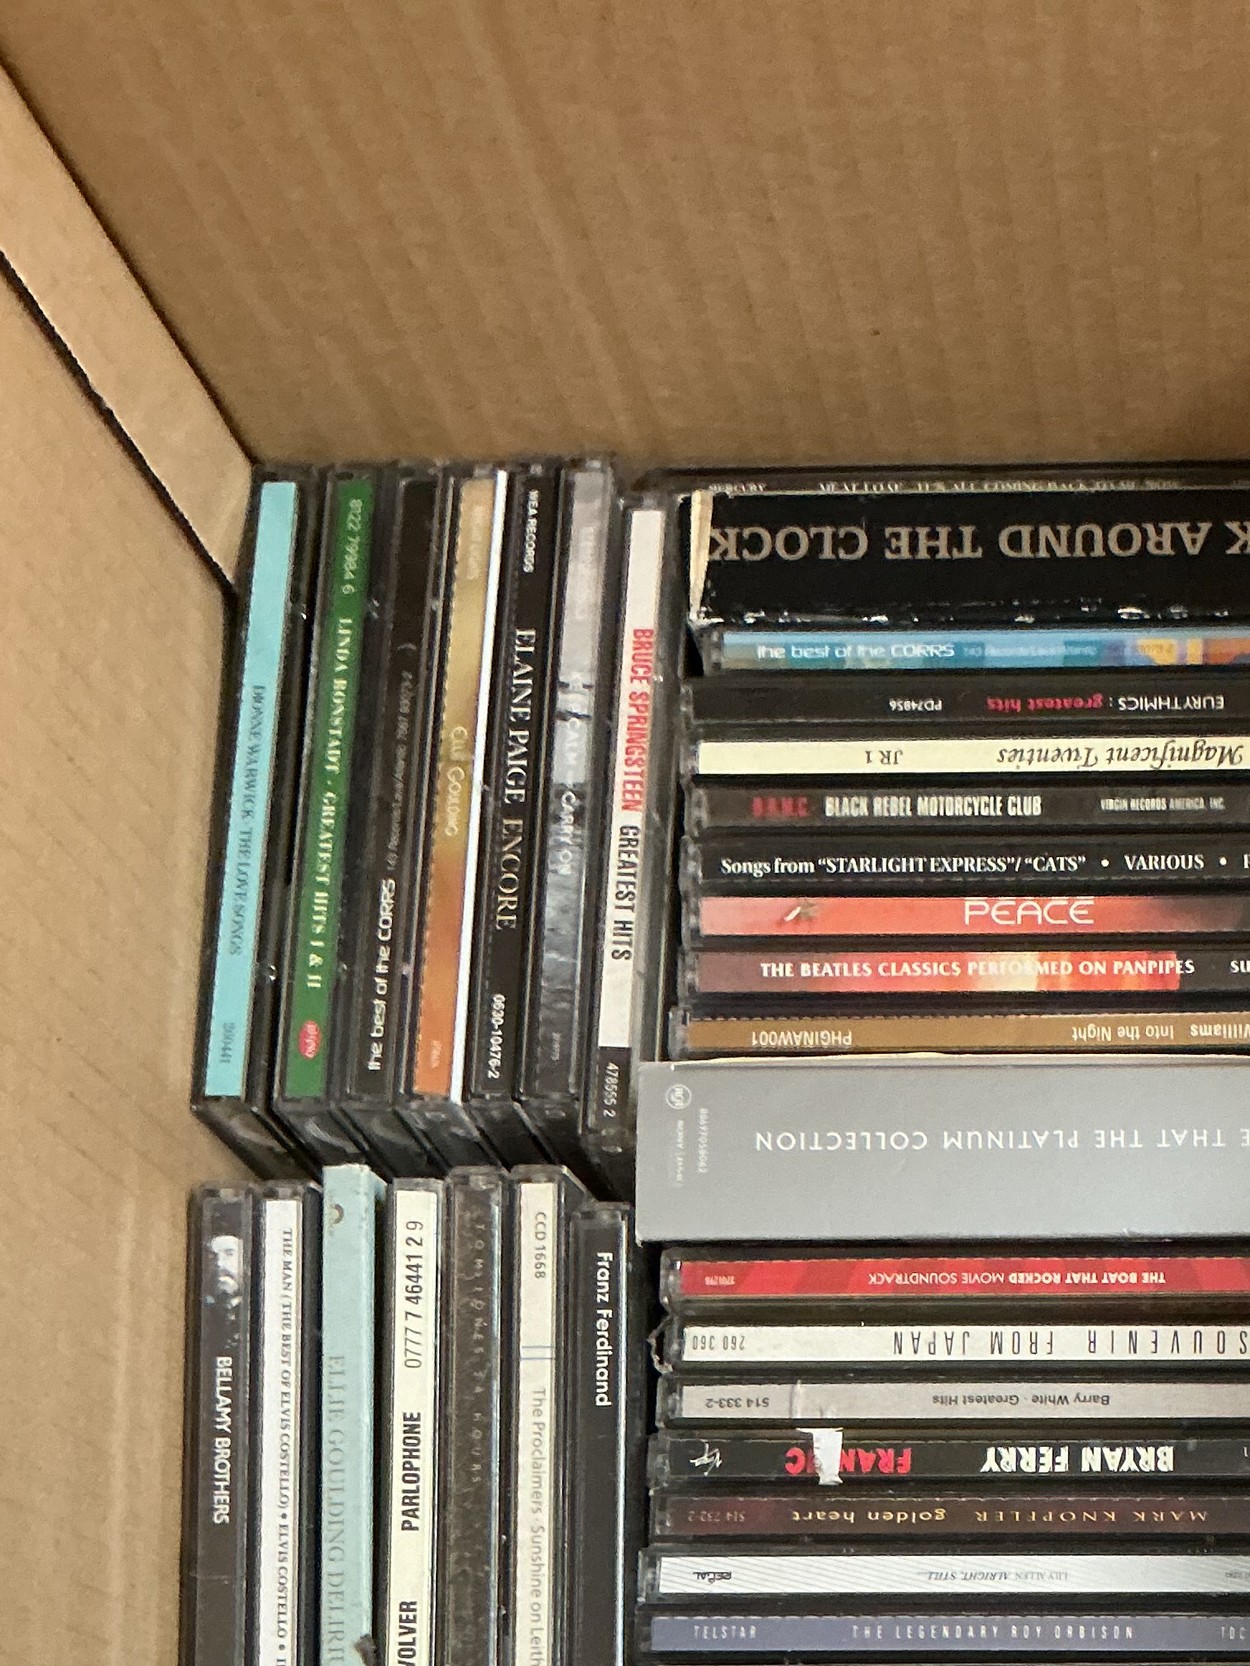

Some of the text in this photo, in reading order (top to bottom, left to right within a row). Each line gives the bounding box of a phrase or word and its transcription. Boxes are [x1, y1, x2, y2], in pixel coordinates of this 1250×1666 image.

[709, 527, 868, 561] CLOCK
[885, 526, 982, 559] THE
[999, 522, 1212, 558] AROUND
[621, 628, 654, 810] BRUCE SPRINGSTEEN
[496, 629, 535, 929] ELAINE PAIGE ENCORE
[612, 826, 640, 960] GREATEST HITS
[965, 900, 1094, 925] PEACE
[1124, 855, 1204, 870] VARIOUS
[596, 1253, 613, 1405] Franz Ferdinand
[213, 1357, 232, 1524] BELLAMY BROTHERS
[401, 1413, 420, 1531] PARLOPHONE
